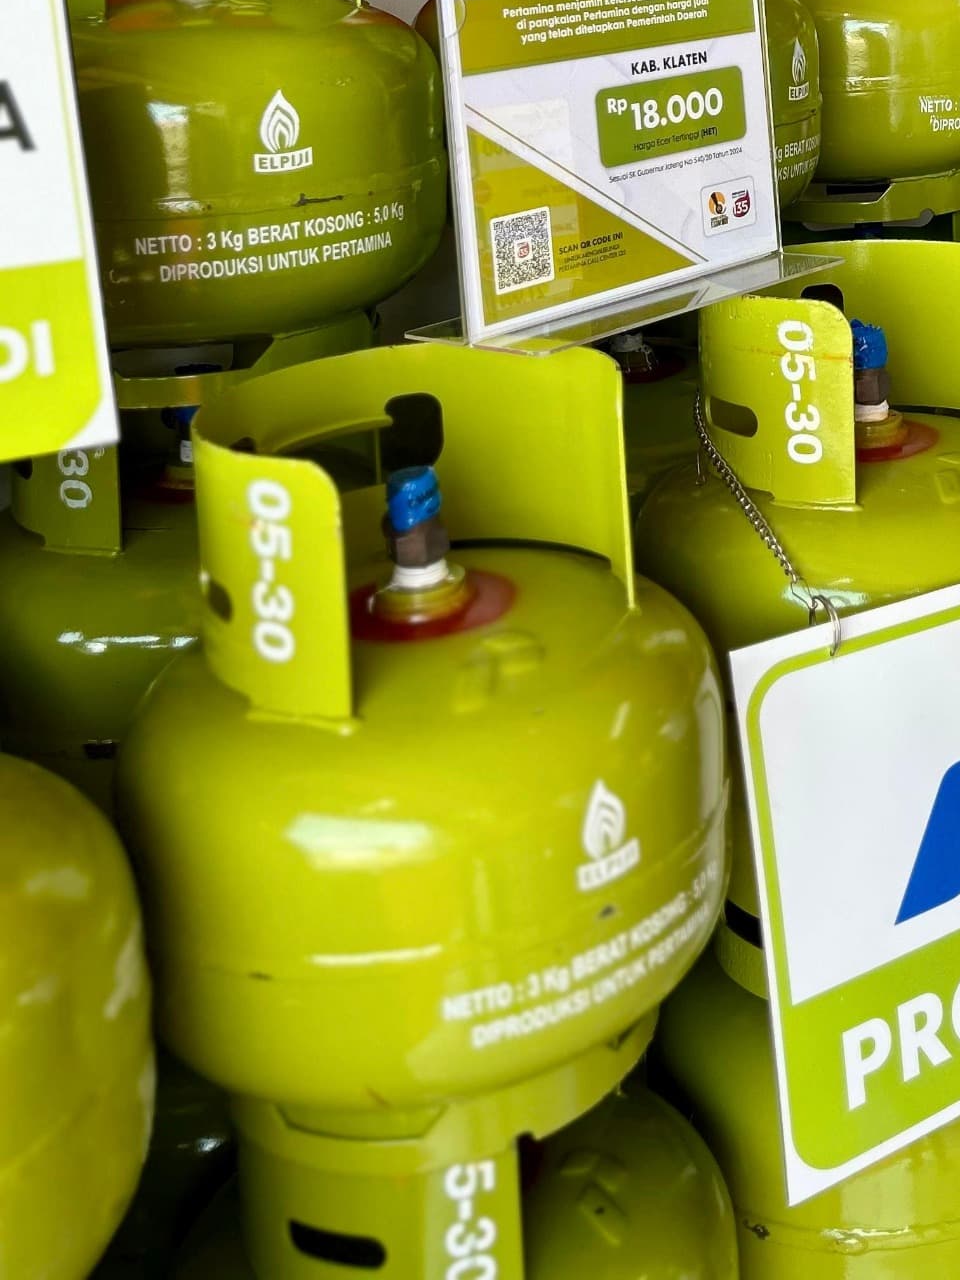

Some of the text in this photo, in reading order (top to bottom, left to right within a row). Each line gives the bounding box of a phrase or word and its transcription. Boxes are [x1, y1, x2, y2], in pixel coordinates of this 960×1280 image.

[503, 4, 554, 19] Pertamina
[516, 20, 527, 31] di
[529, 13, 582, 29] pangkalan
[583, 7, 630, 21] Pertamina
[631, 2, 665, 17] dengan
[666, 0, 692, 12] harga
[520, 8, 708, 45] yang telah ditetapkan Pemerintah Daerah
[630, 51, 708, 76] KAB. KLATEN
[607, 87, 724, 131] Rp 18.000
[920, 97, 953, 113] NETTO
[633, 126, 718, 152] Harga Ecer Tertinggi (HET)
[257, 148, 311, 172] ELPIJI
[135, 201, 405, 256] NETTO 3 Kg BERAT KOSONG 5,0 Kg
[559, 235, 611, 255] SCAN CODE
[159, 230, 393, 282] DIPRODUKSI UNTUK PERTAMINA
[775, 320, 824, 464] 05-30
[247, 479, 296, 664] 05-30
[442, 983, 513, 1021] NETTO
[528, 973, 540, 998] 3
[544, 966, 570, 993] Kg
[572, 933, 628, 980] BERAT
[471, 956, 648, 1049] DIPRODUKSI UNTUK
[445, 1159, 497, 1280] 5-30
